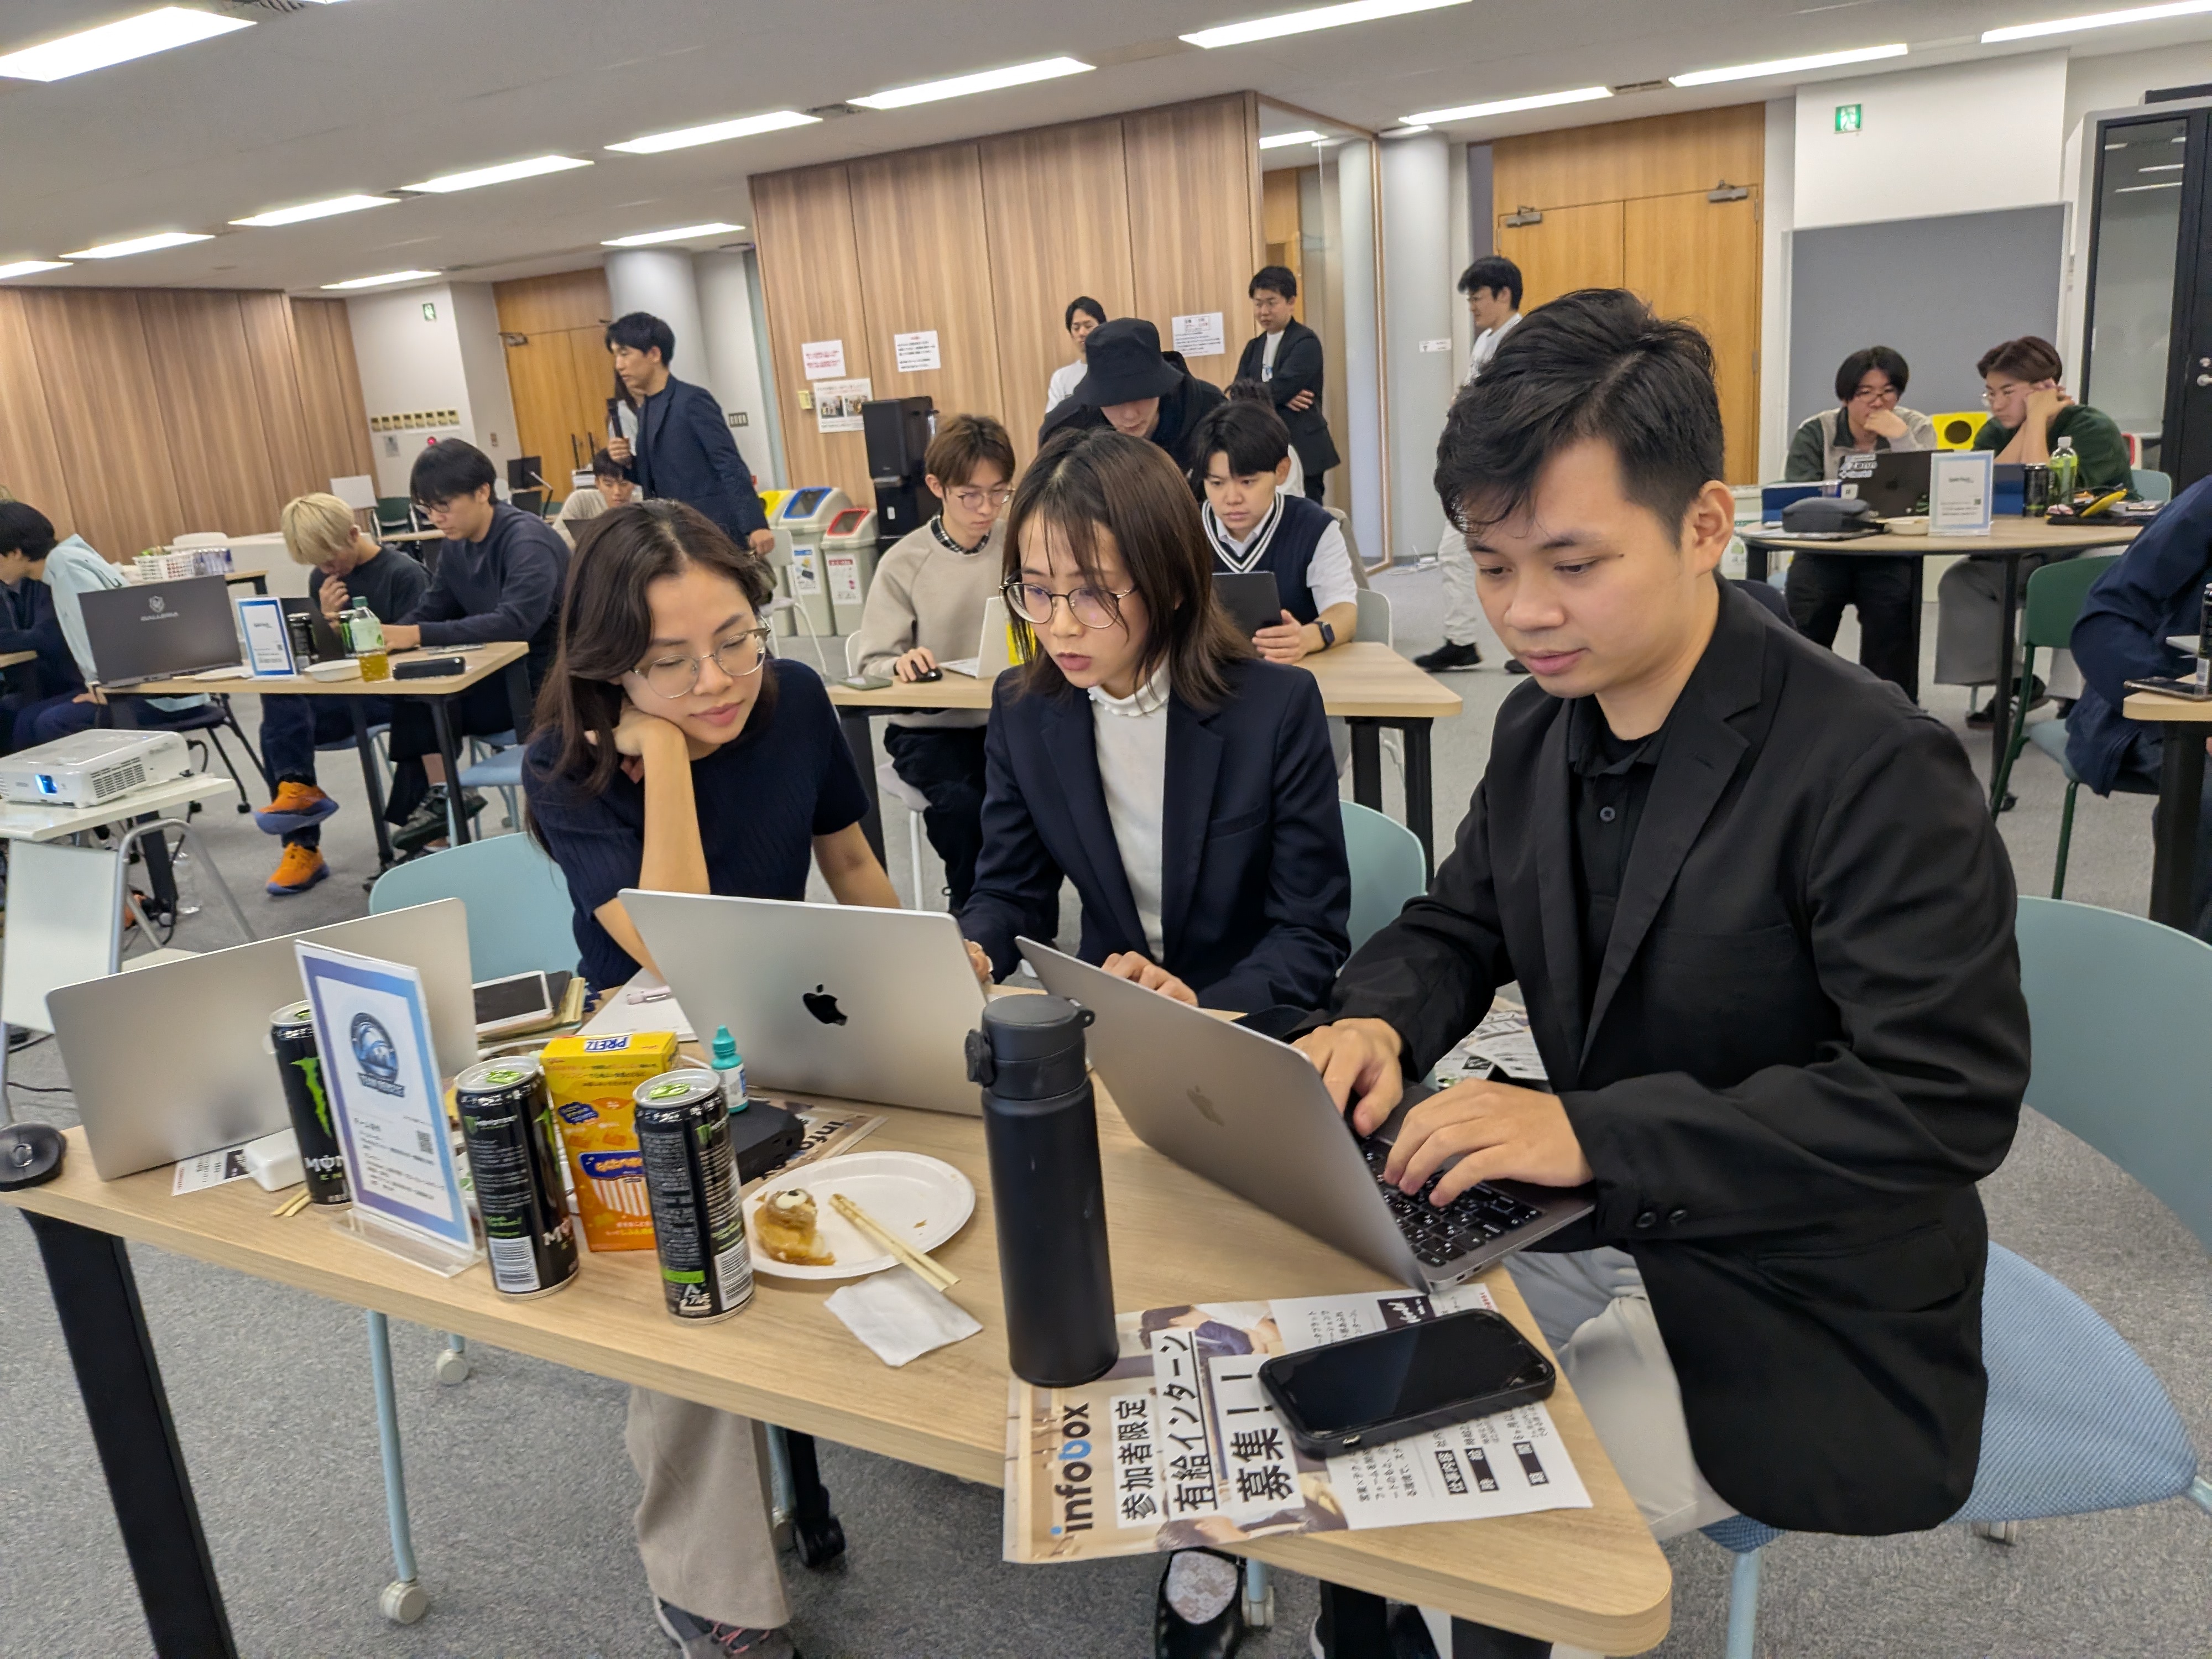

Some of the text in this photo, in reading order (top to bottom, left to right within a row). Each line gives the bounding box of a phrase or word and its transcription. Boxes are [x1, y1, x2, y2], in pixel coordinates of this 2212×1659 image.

[586, 1036, 629, 1051] PRETZ
[1050, 1401, 1094, 1538] infobox
[1115, 1397, 1157, 1521] 参加者限定
[1159, 1335, 1217, 1512] 有給インターン
